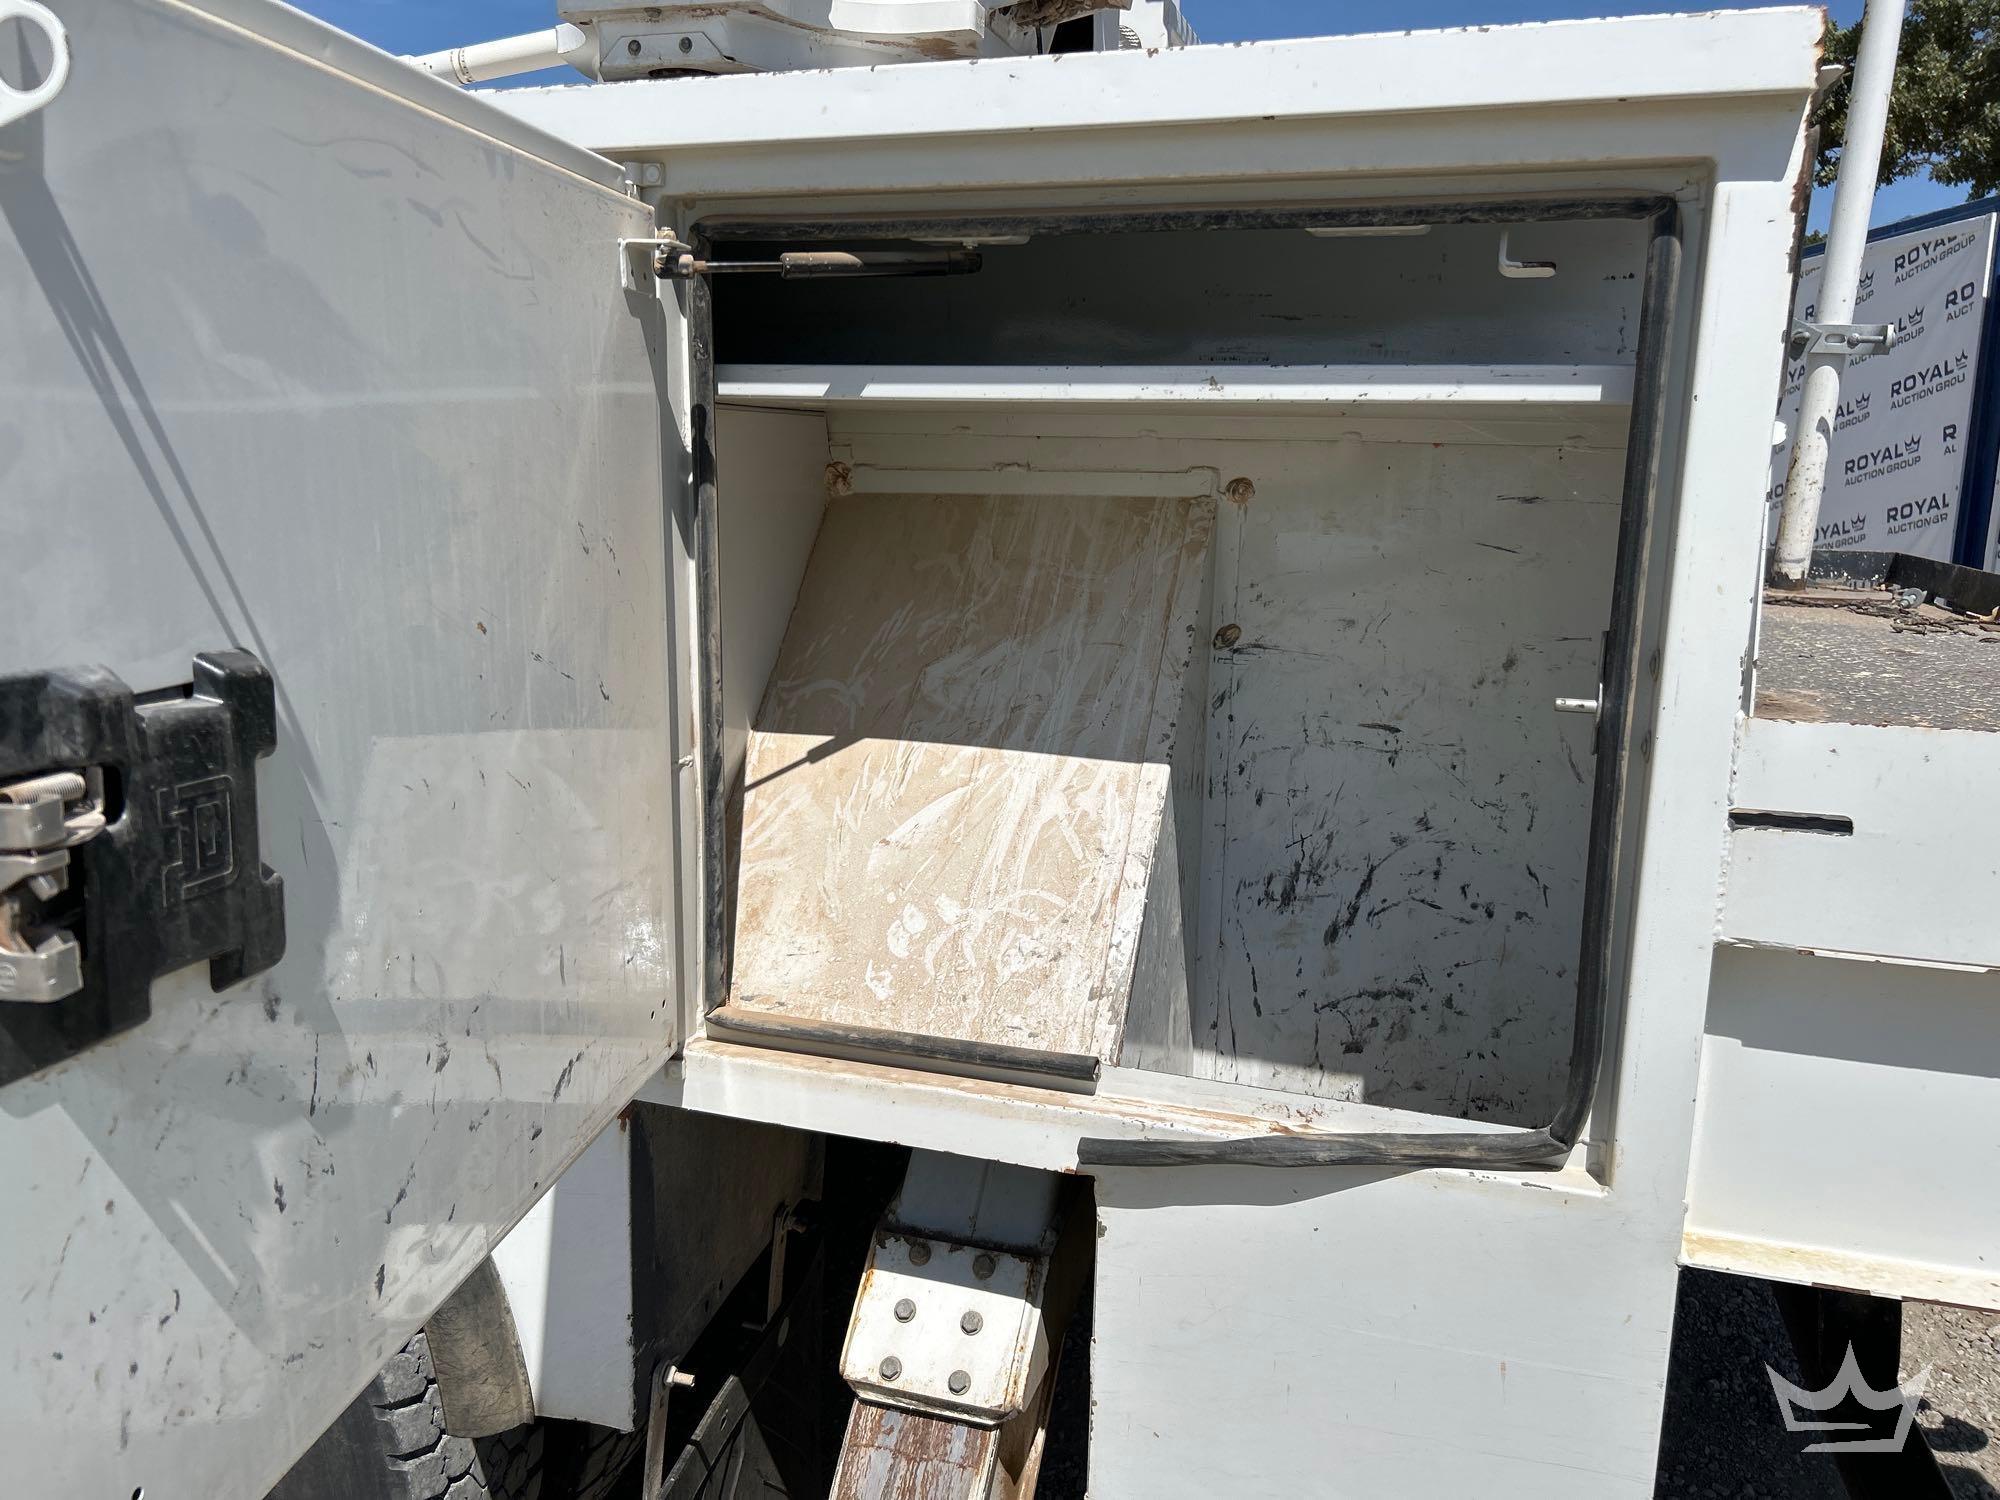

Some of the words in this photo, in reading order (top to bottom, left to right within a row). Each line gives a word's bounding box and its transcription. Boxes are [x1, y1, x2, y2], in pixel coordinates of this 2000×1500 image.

[1895, 256, 1938, 286] AUCTION
[1939, 234, 1976, 261] GROUP
[1897, 326, 1925, 346] ROUP
[1890, 386, 1934, 410] AUCTION
[1935, 372, 1966, 392] GROU
[1891, 360, 1954, 398] ROYAL
[1839, 412, 1870, 431] GROUP
[1844, 467, 1885, 487] AUCTION
[1886, 456, 1921, 473] GROUP
[1845, 443, 1904, 475] ROYAL
[1887, 493, 1949, 523] ROYAL
[1835, 533, 1866, 549] GROUP
[1887, 517, 1931, 536] AUCTION
